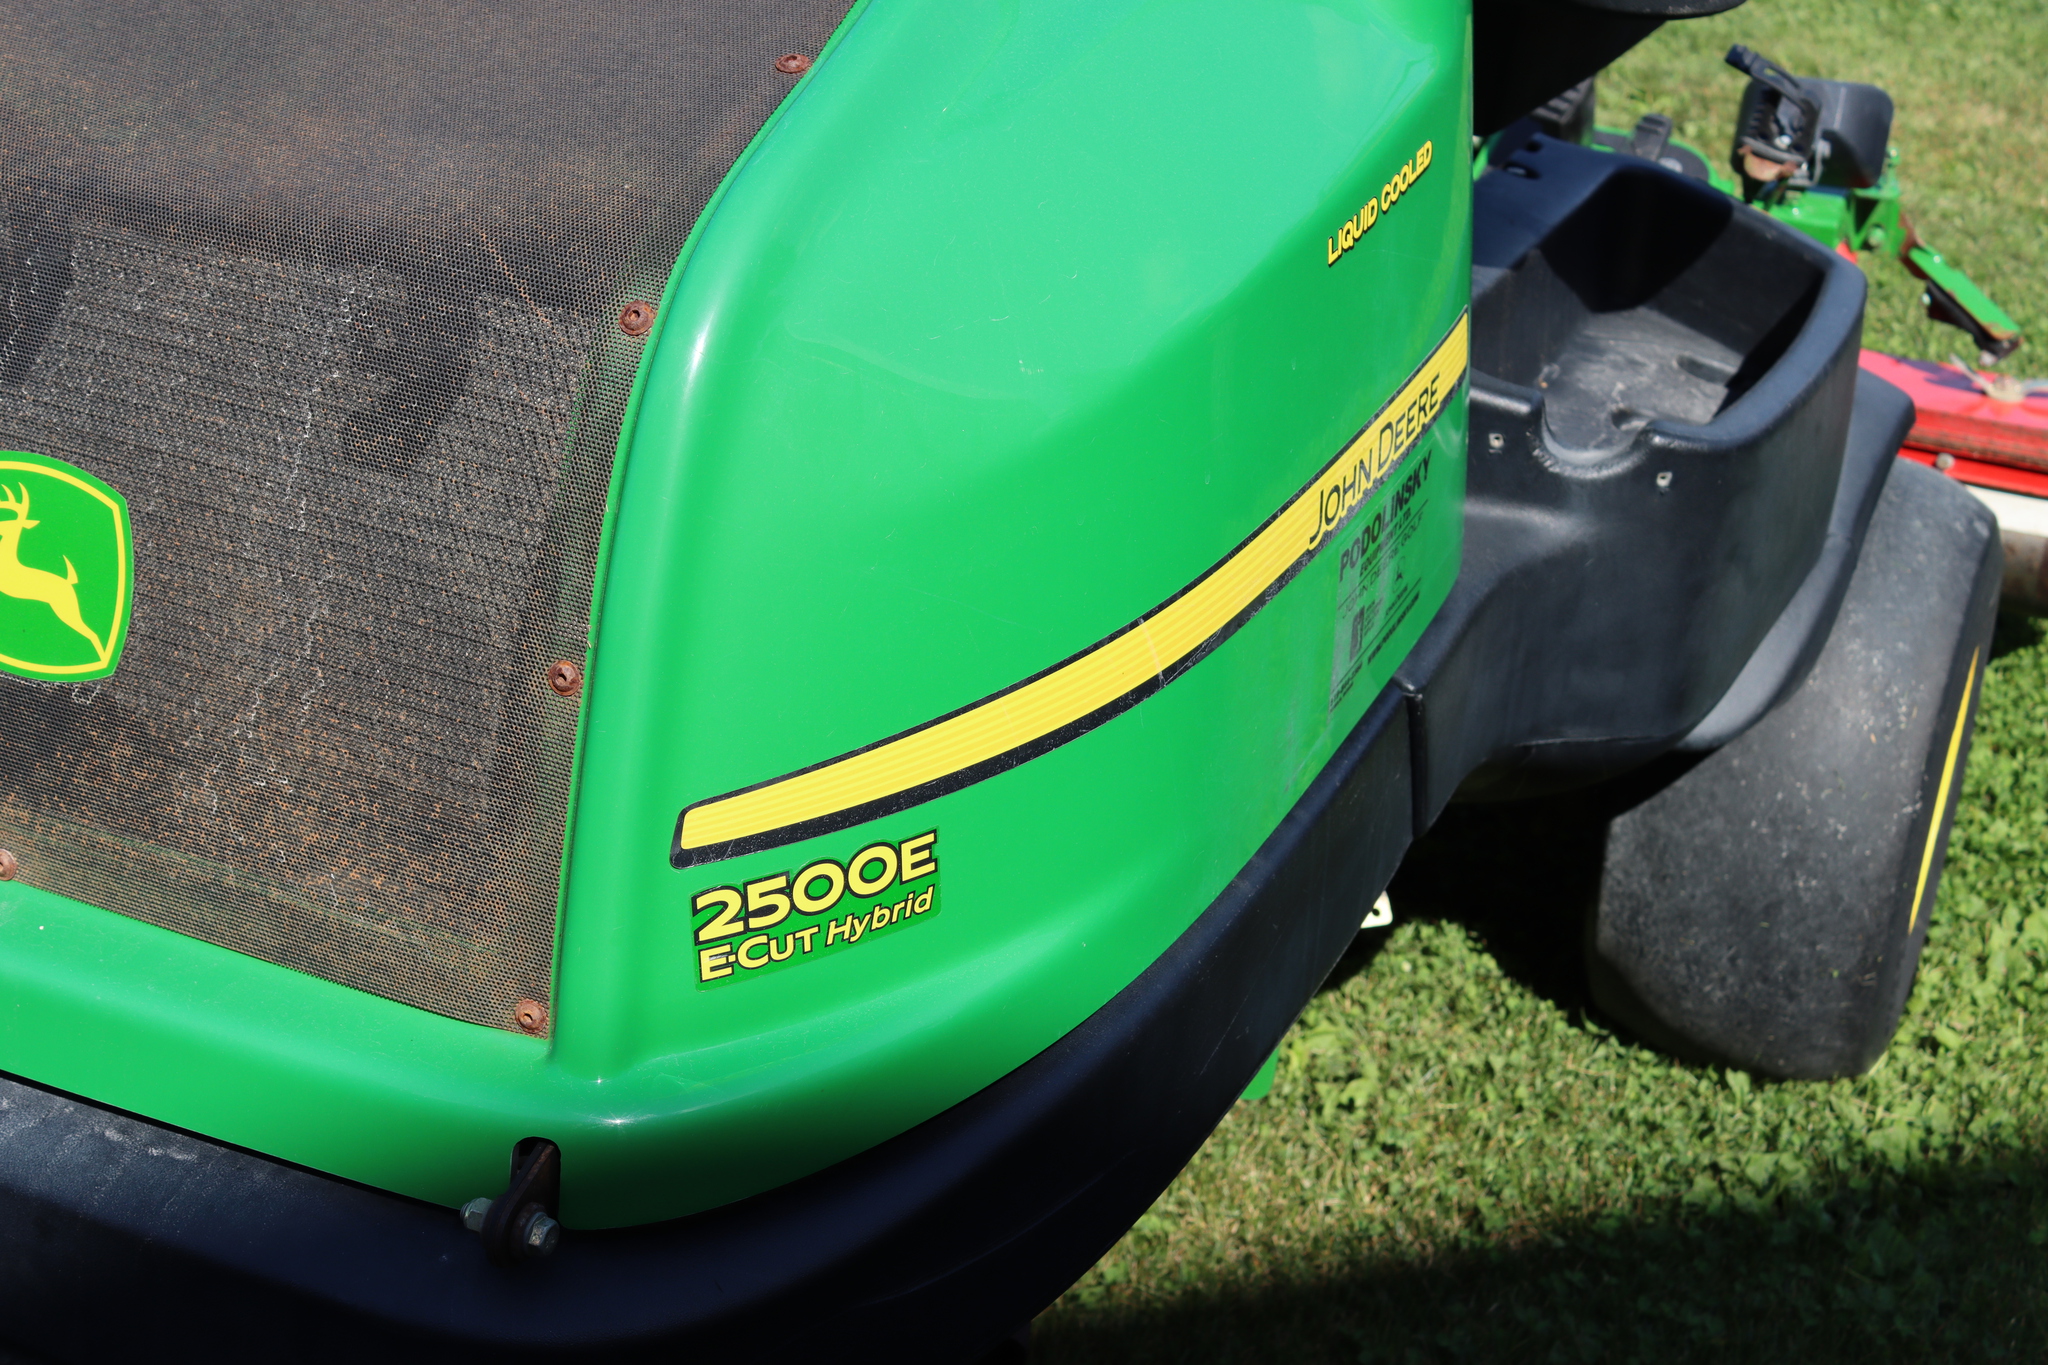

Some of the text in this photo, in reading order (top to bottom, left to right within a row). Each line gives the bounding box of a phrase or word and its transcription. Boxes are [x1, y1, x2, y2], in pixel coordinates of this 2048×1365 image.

[1327, 140, 1433, 267] LIQUID COOLED
[1309, 371, 1440, 544] JOHN DEERE
[1339, 450, 1432, 582] PODOLINSKY
[692, 829, 938, 946] 2500E
[825, 884, 936, 948] Hybrid
